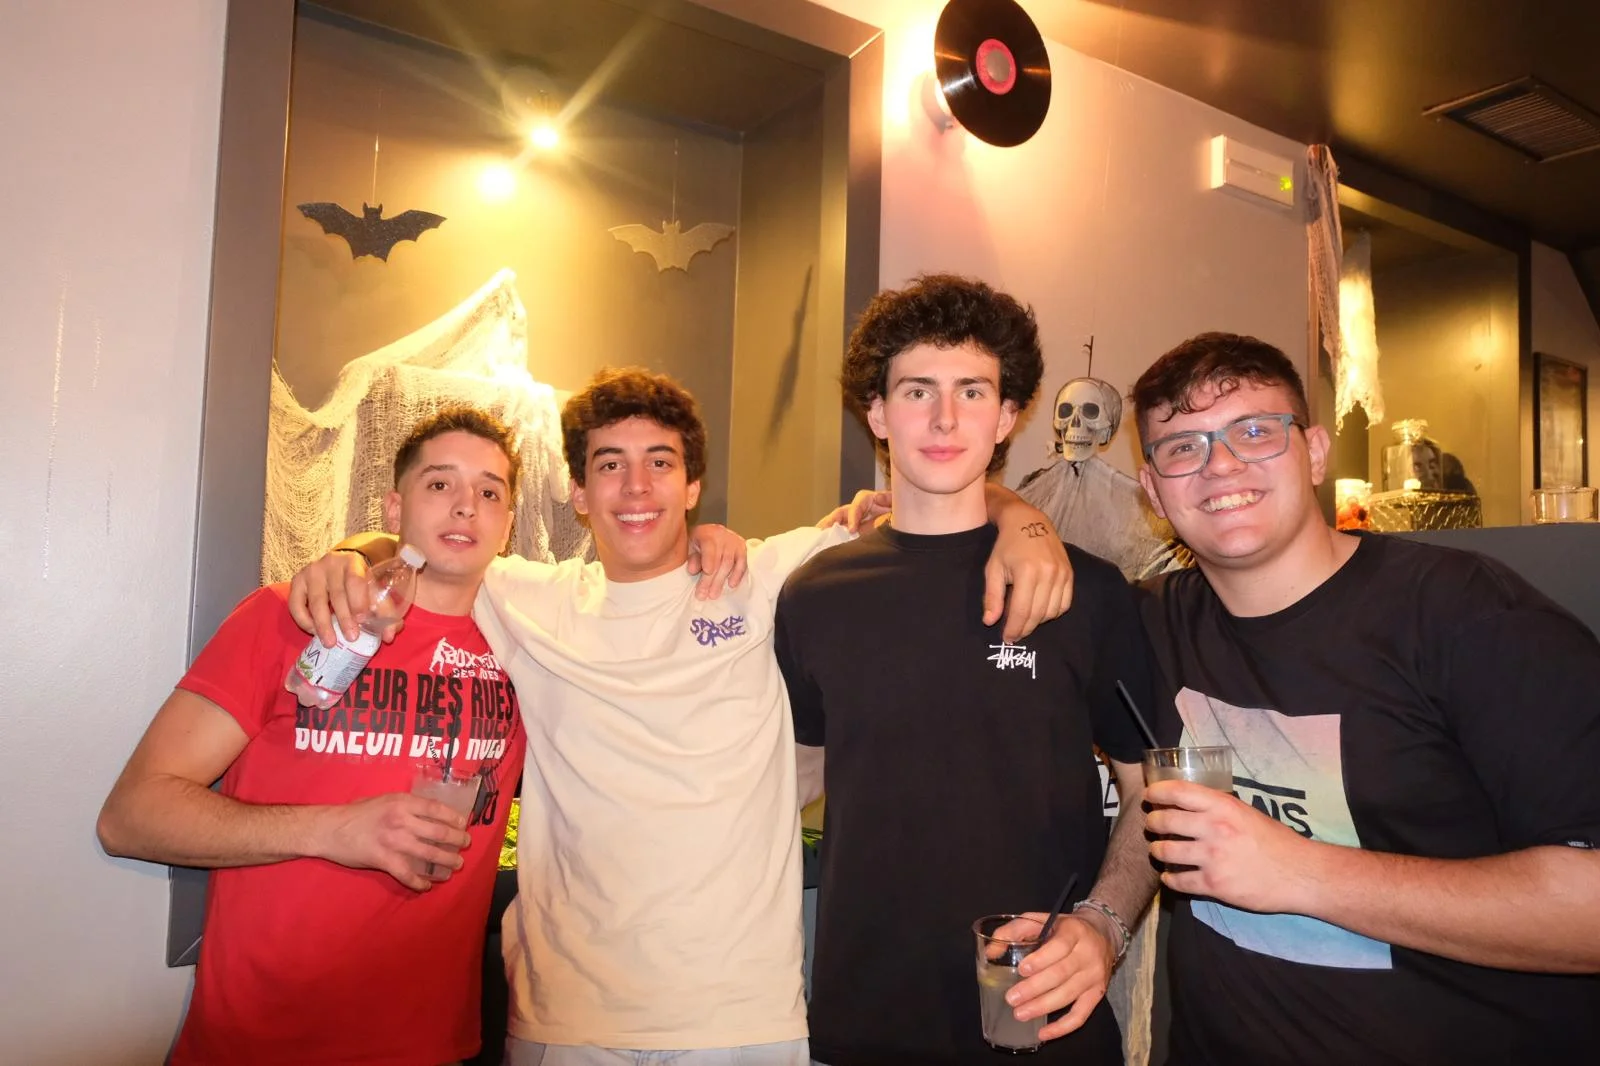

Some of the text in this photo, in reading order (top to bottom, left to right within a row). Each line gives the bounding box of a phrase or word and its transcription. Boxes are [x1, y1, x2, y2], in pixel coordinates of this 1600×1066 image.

[1021, 522, 1049, 538] 223
[334, 667, 409, 712] EUR
[416, 673, 463, 717] DES
[471, 677, 516, 721] RUES
[1232, 785, 1314, 839] NS
